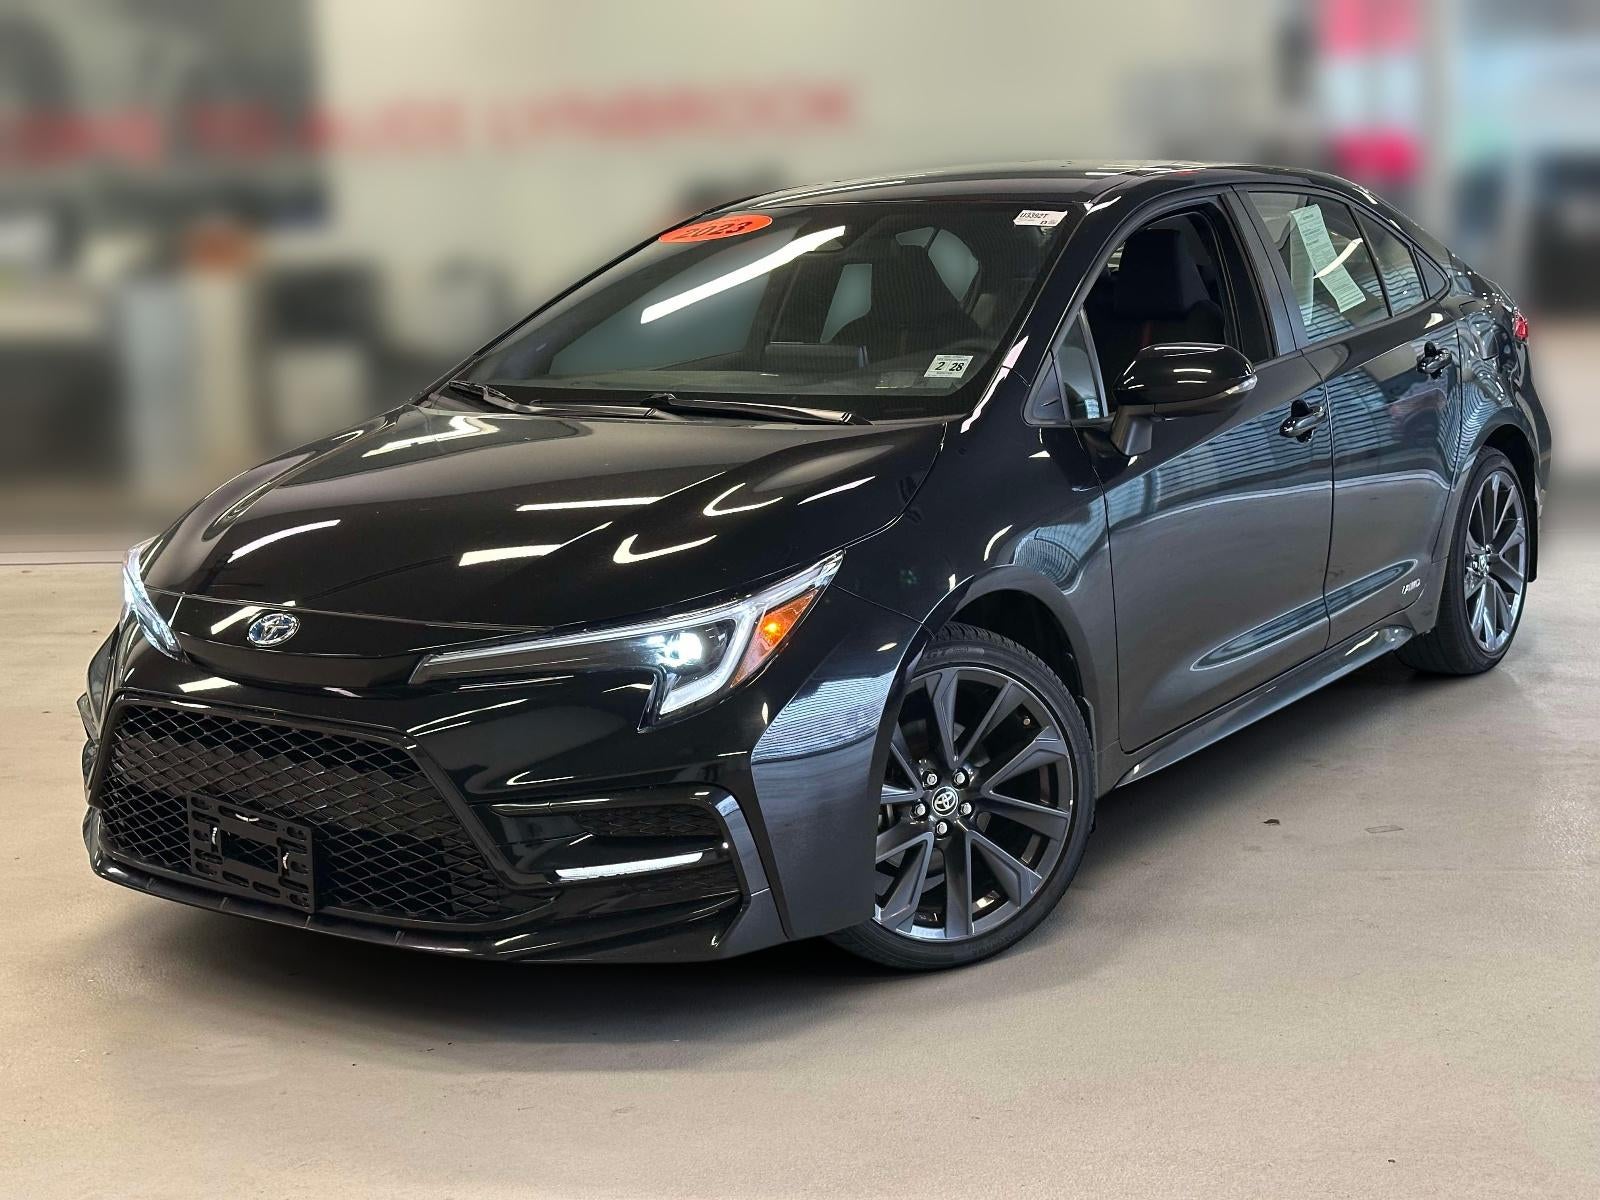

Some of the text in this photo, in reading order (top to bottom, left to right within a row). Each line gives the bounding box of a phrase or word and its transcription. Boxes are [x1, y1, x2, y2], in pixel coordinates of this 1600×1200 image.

[670, 221, 753, 241] 2023
[934, 361, 965, 372] 2 28
